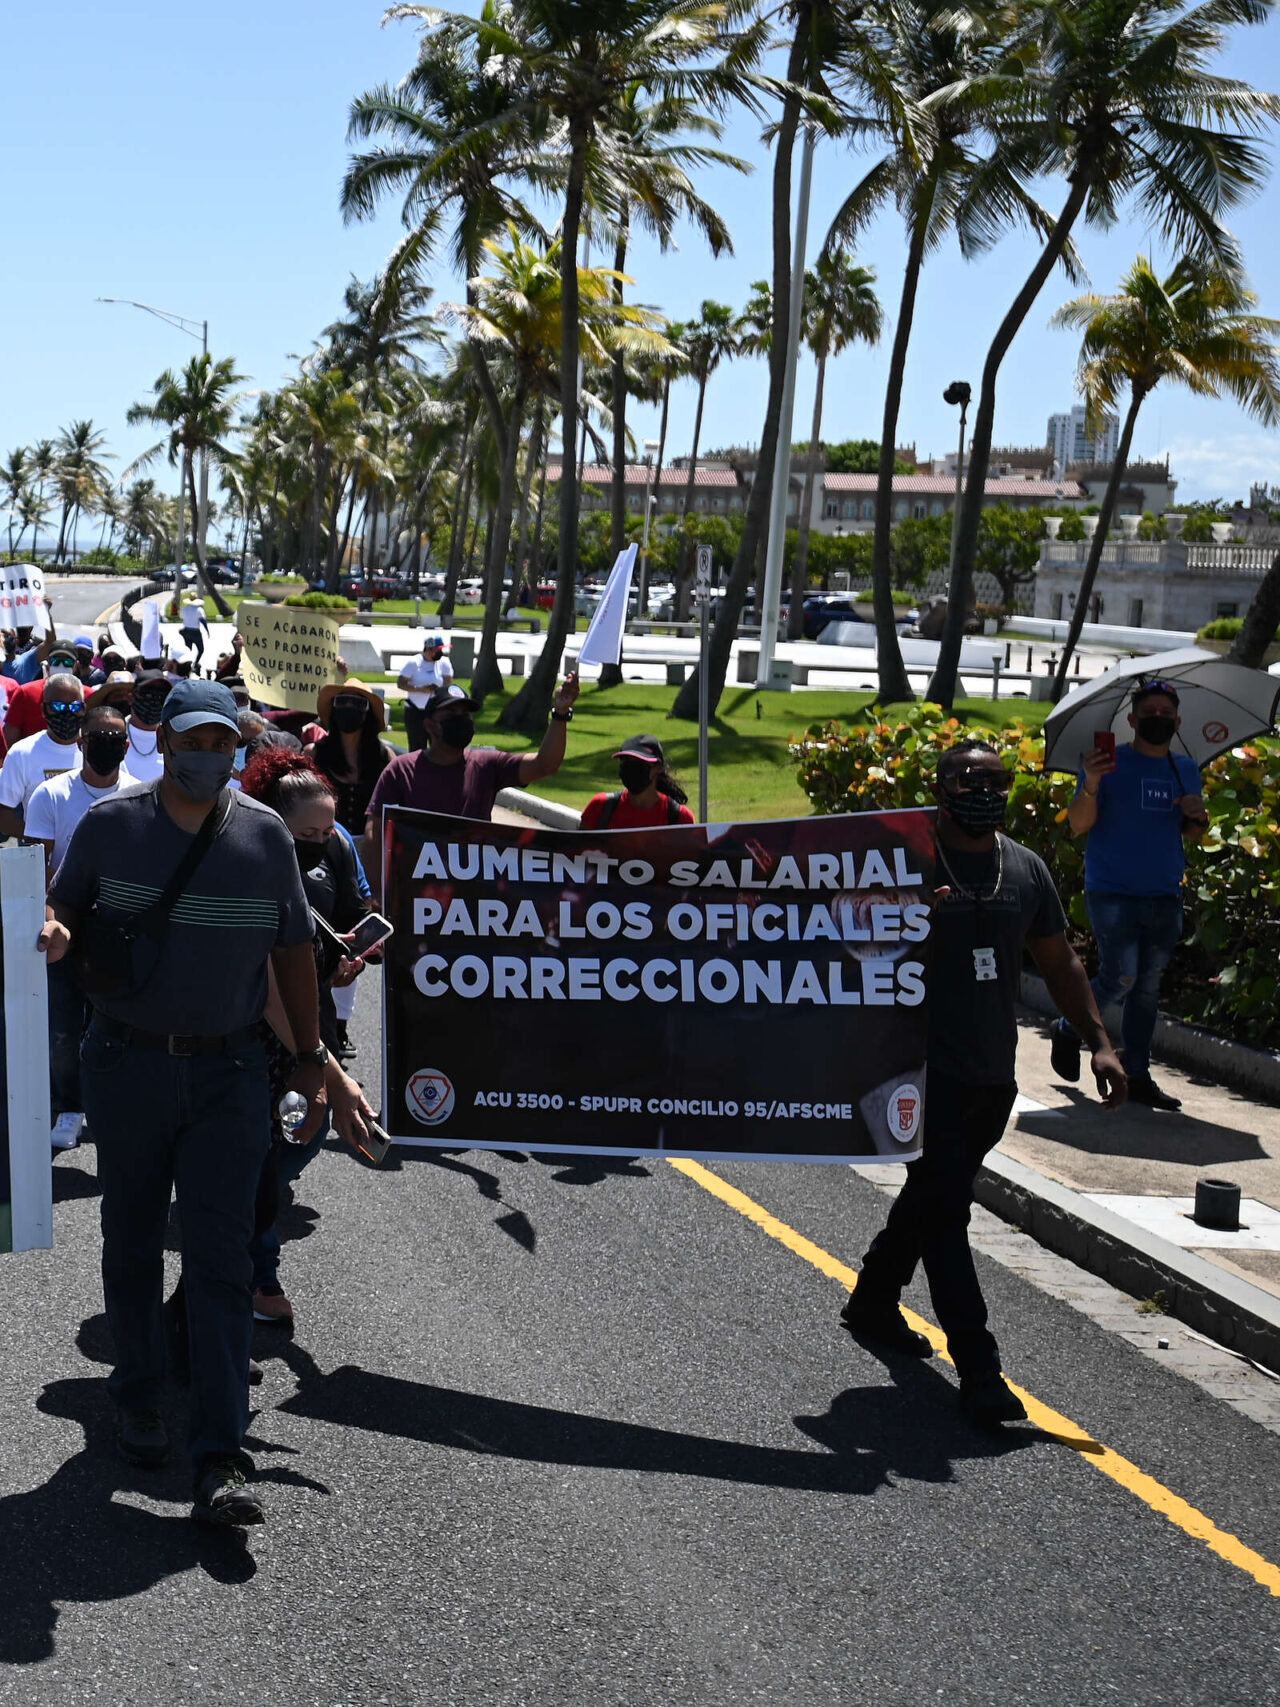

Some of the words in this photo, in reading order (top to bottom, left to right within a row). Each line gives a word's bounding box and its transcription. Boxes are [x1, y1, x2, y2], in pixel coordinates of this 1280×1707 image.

[245, 615, 260, 628] SE
[273, 621, 336, 643] ACABARON
[246, 635, 268, 649] LAS
[274, 640, 337, 663] PROMESAS
[258, 657, 329, 677] QUEREMOS
[249, 672, 272, 687] QUE
[280, 679, 321, 693] CUMP
[412, 842, 655, 886] AUMENTO
[668, 847, 923, 889] SALARIAL
[413, 898, 545, 938] PARA
[559, 901, 653, 940] LOS
[667, 903, 931, 942] OFICIALES
[413, 954, 926, 1006] CORRECCIONALES
[474, 1091, 512, 1107] ACU
[517, 1093, 563, 1110] 3500
[580, 1096, 642, 1113] SPUPR
[647, 1099, 739, 1117] CONCILIO
[744, 1101, 853, 1120] 95/AFSCME
